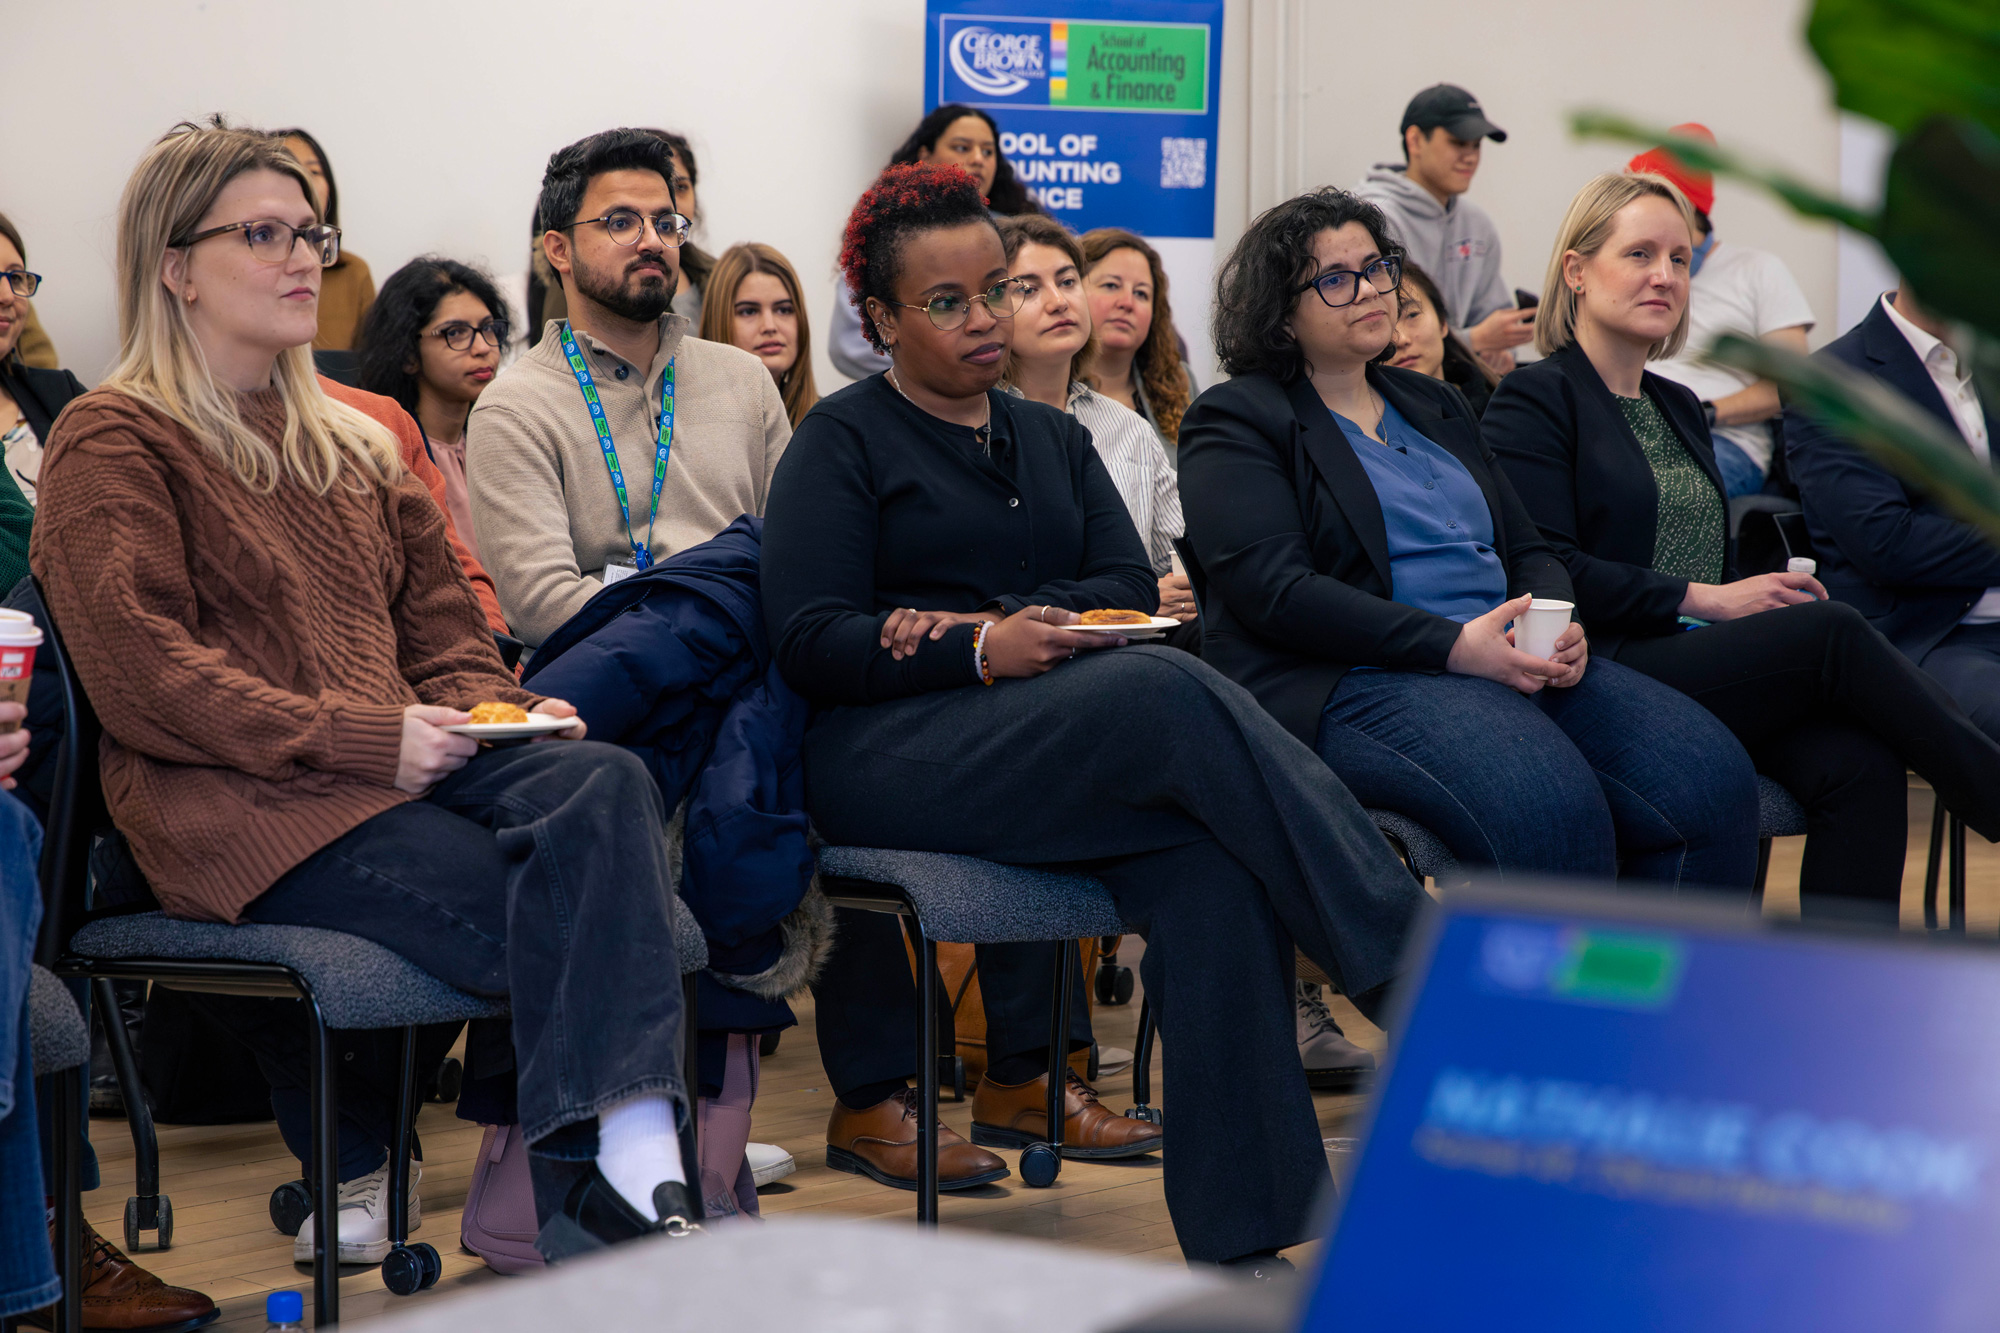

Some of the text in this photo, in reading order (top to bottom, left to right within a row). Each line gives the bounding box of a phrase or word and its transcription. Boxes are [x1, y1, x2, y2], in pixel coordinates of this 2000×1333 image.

[964, 33, 1042, 54] GEORGE
[1100, 32, 1147, 49] School of
[973, 50, 1044, 71] BROWN
[1086, 43, 1186, 82] Accounting
[1090, 72, 1176, 102] & Finance
[999, 132, 1098, 156] OOL OF
[1010, 160, 1121, 185] UNTING
